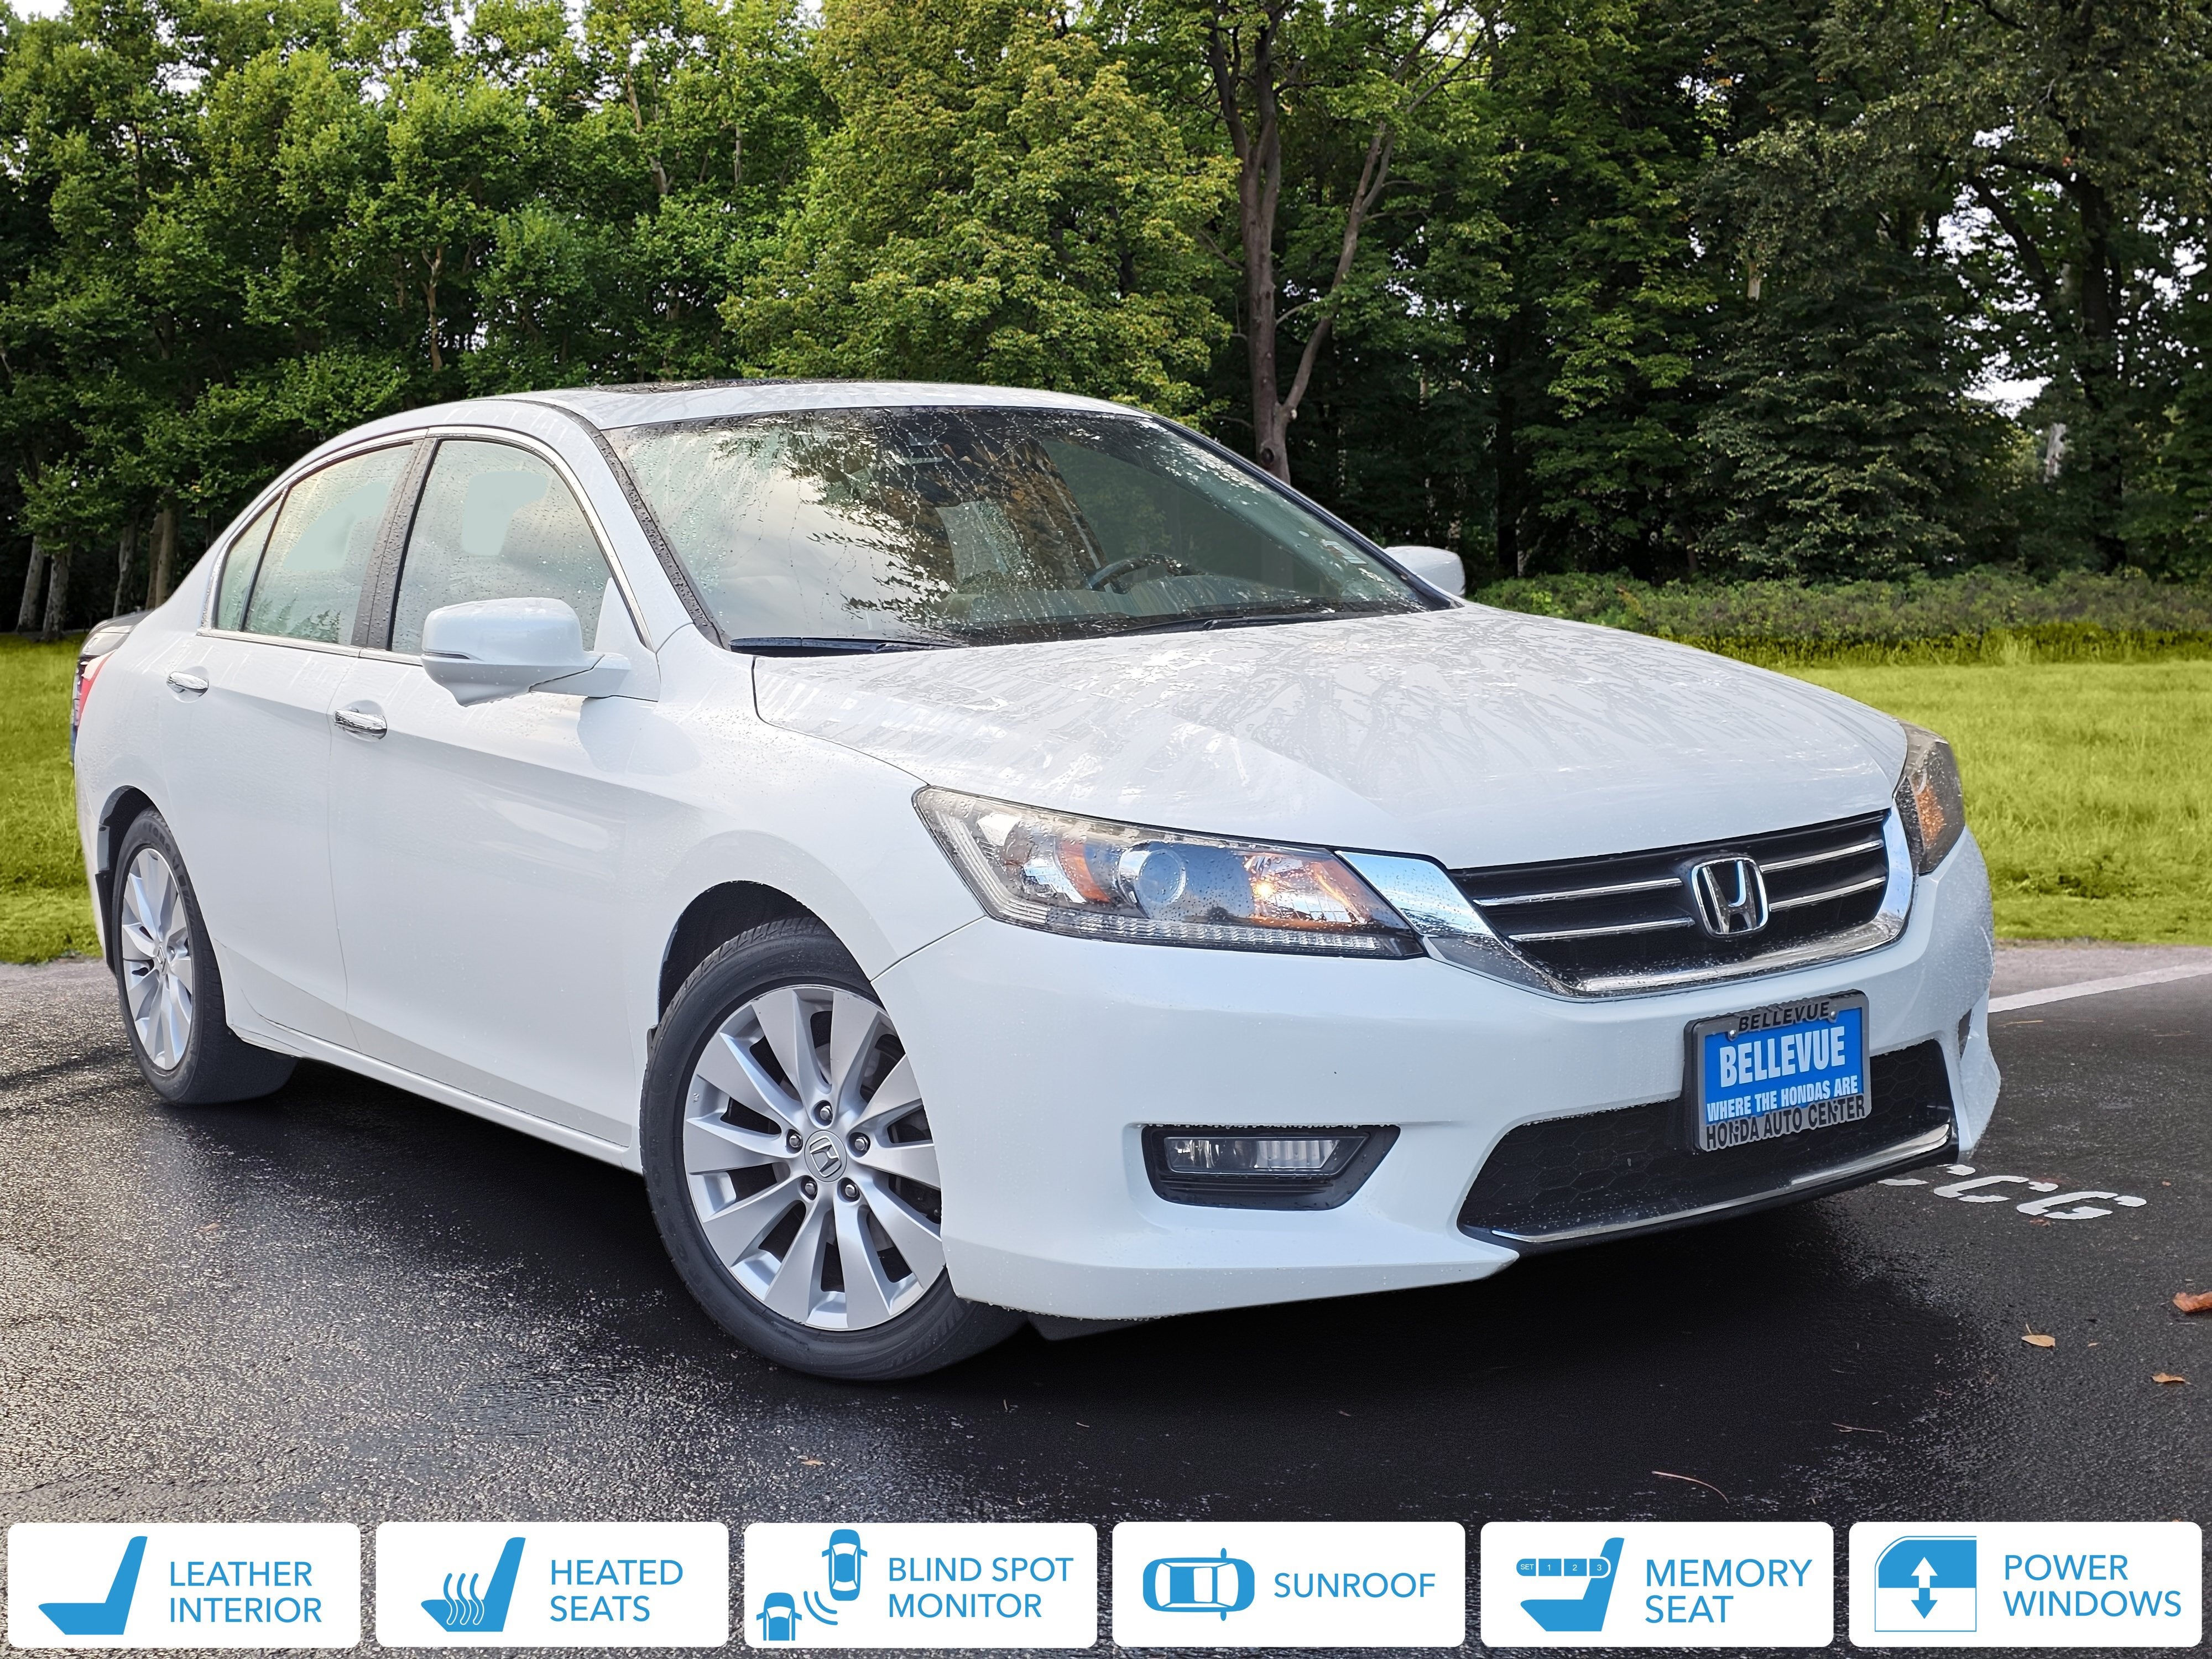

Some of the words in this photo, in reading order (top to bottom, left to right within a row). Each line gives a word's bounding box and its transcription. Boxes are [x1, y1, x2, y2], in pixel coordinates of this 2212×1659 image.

[1738, 1001, 1830, 1032] BELLEVUE
[1719, 1026, 1846, 1088] BELLEVUE
[1705, 1119, 1760, 1150] HONDA
[1763, 1107, 1803, 1138] AUTO
[1808, 1094, 1865, 1127] CENTER
[1707, 1095, 1751, 1122] WHERE
[1754, 1090, 1777, 1113] THE
[1781, 1080, 1830, 1107] HONDAS
[1834, 1074, 1859, 1098] ARE
